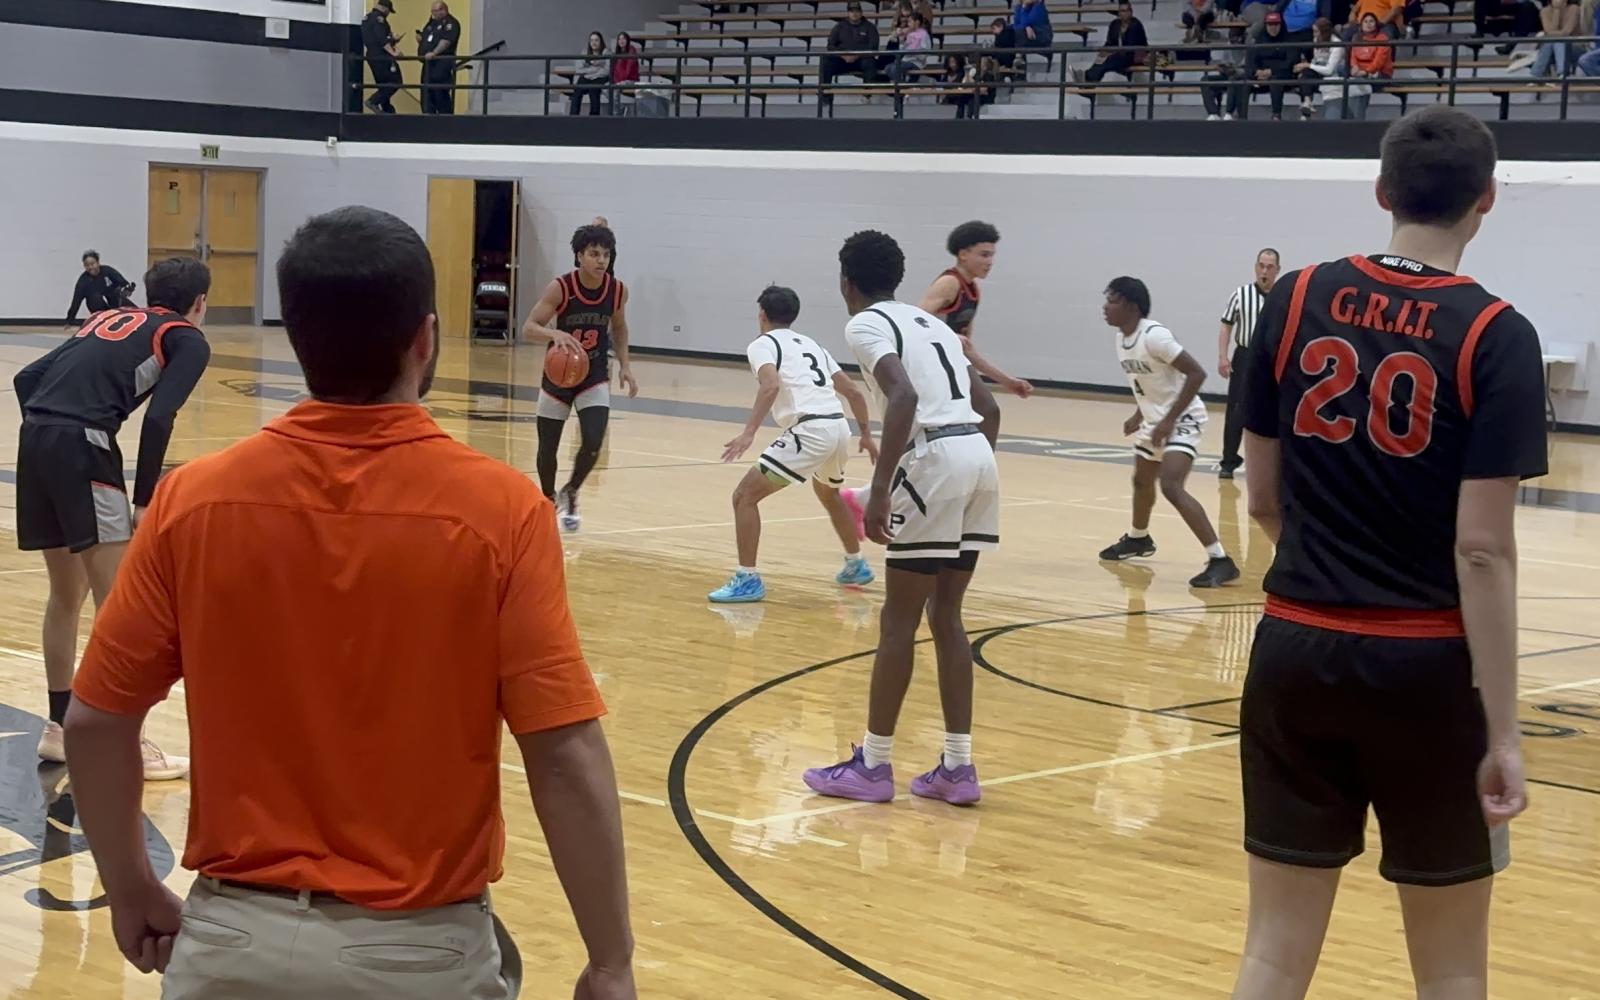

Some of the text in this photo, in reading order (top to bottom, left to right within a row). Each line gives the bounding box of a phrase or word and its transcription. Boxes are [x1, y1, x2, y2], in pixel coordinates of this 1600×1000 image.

[168, 181, 179, 191] P
[1379, 256, 1424, 272] NIKE PRO
[75, 308, 148, 341] 10
[1330, 286, 1438, 340] G.R.I.T.
[802, 352, 826, 387] 3
[930, 342, 965, 400] 1
[1294, 336, 1437, 457] 20
[770, 439, 786, 449] P
[889, 513, 906, 529] P
